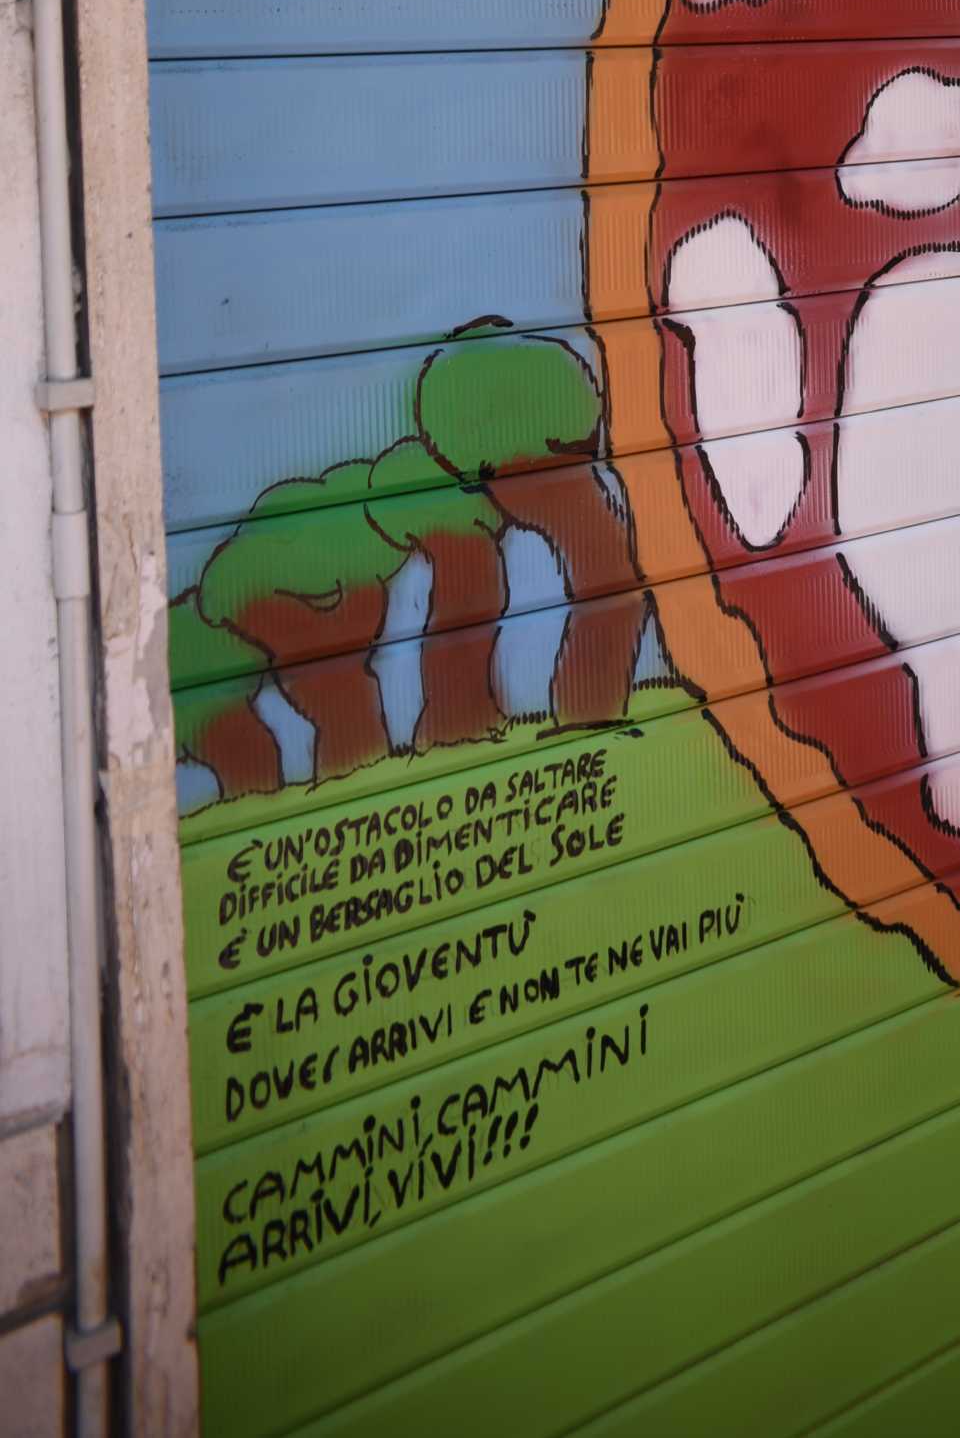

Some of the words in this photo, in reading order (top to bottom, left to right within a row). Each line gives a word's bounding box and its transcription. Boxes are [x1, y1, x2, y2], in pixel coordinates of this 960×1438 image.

[265, 796, 453, 871] UN'OSTACOLO
[465, 782, 497, 816] DA
[506, 750, 607, 803] SALTARE
[351, 849, 386, 884] DA
[394, 776, 618, 874] DIMENTICARE
[257, 916, 301, 957] UN
[310, 861, 465, 943] BERSAGLIO
[476, 844, 533, 889] DEL
[550, 812, 625, 867] SOLE
[276, 988, 319, 1034] LA
[349, 1003, 453, 1075] ARRIVI
[469, 989, 493, 1025] E
[500, 967, 560, 1015] NON
[565, 952, 599, 986] TE
[607, 935, 643, 976] NE
[649, 921, 688, 961] VAI
[438, 1004, 649, 1136] CAMMINI
